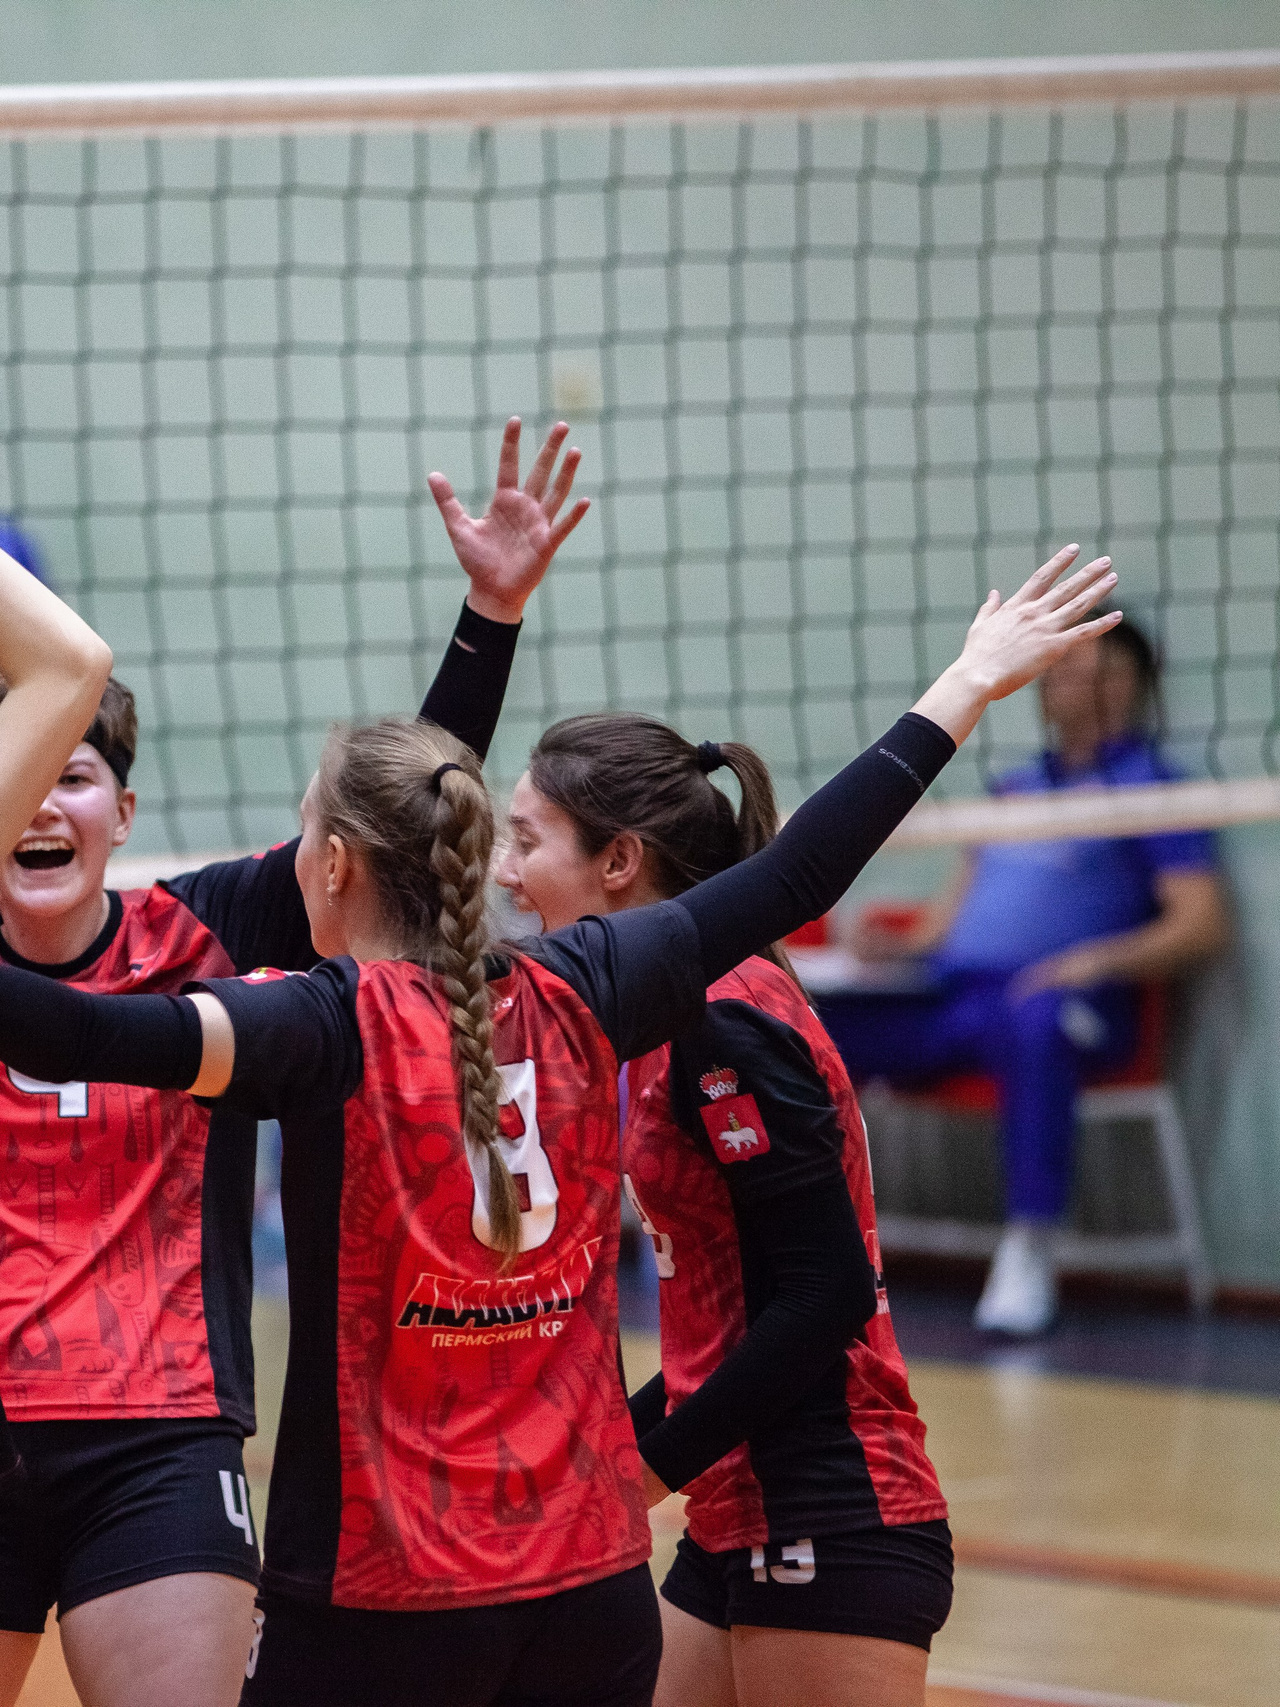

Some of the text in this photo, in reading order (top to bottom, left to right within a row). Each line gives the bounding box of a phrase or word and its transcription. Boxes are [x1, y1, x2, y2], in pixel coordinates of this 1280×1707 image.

[430, 1319, 568, 1349] ПЕРМСКИЙ КР
[218, 1469, 254, 1547] 4
